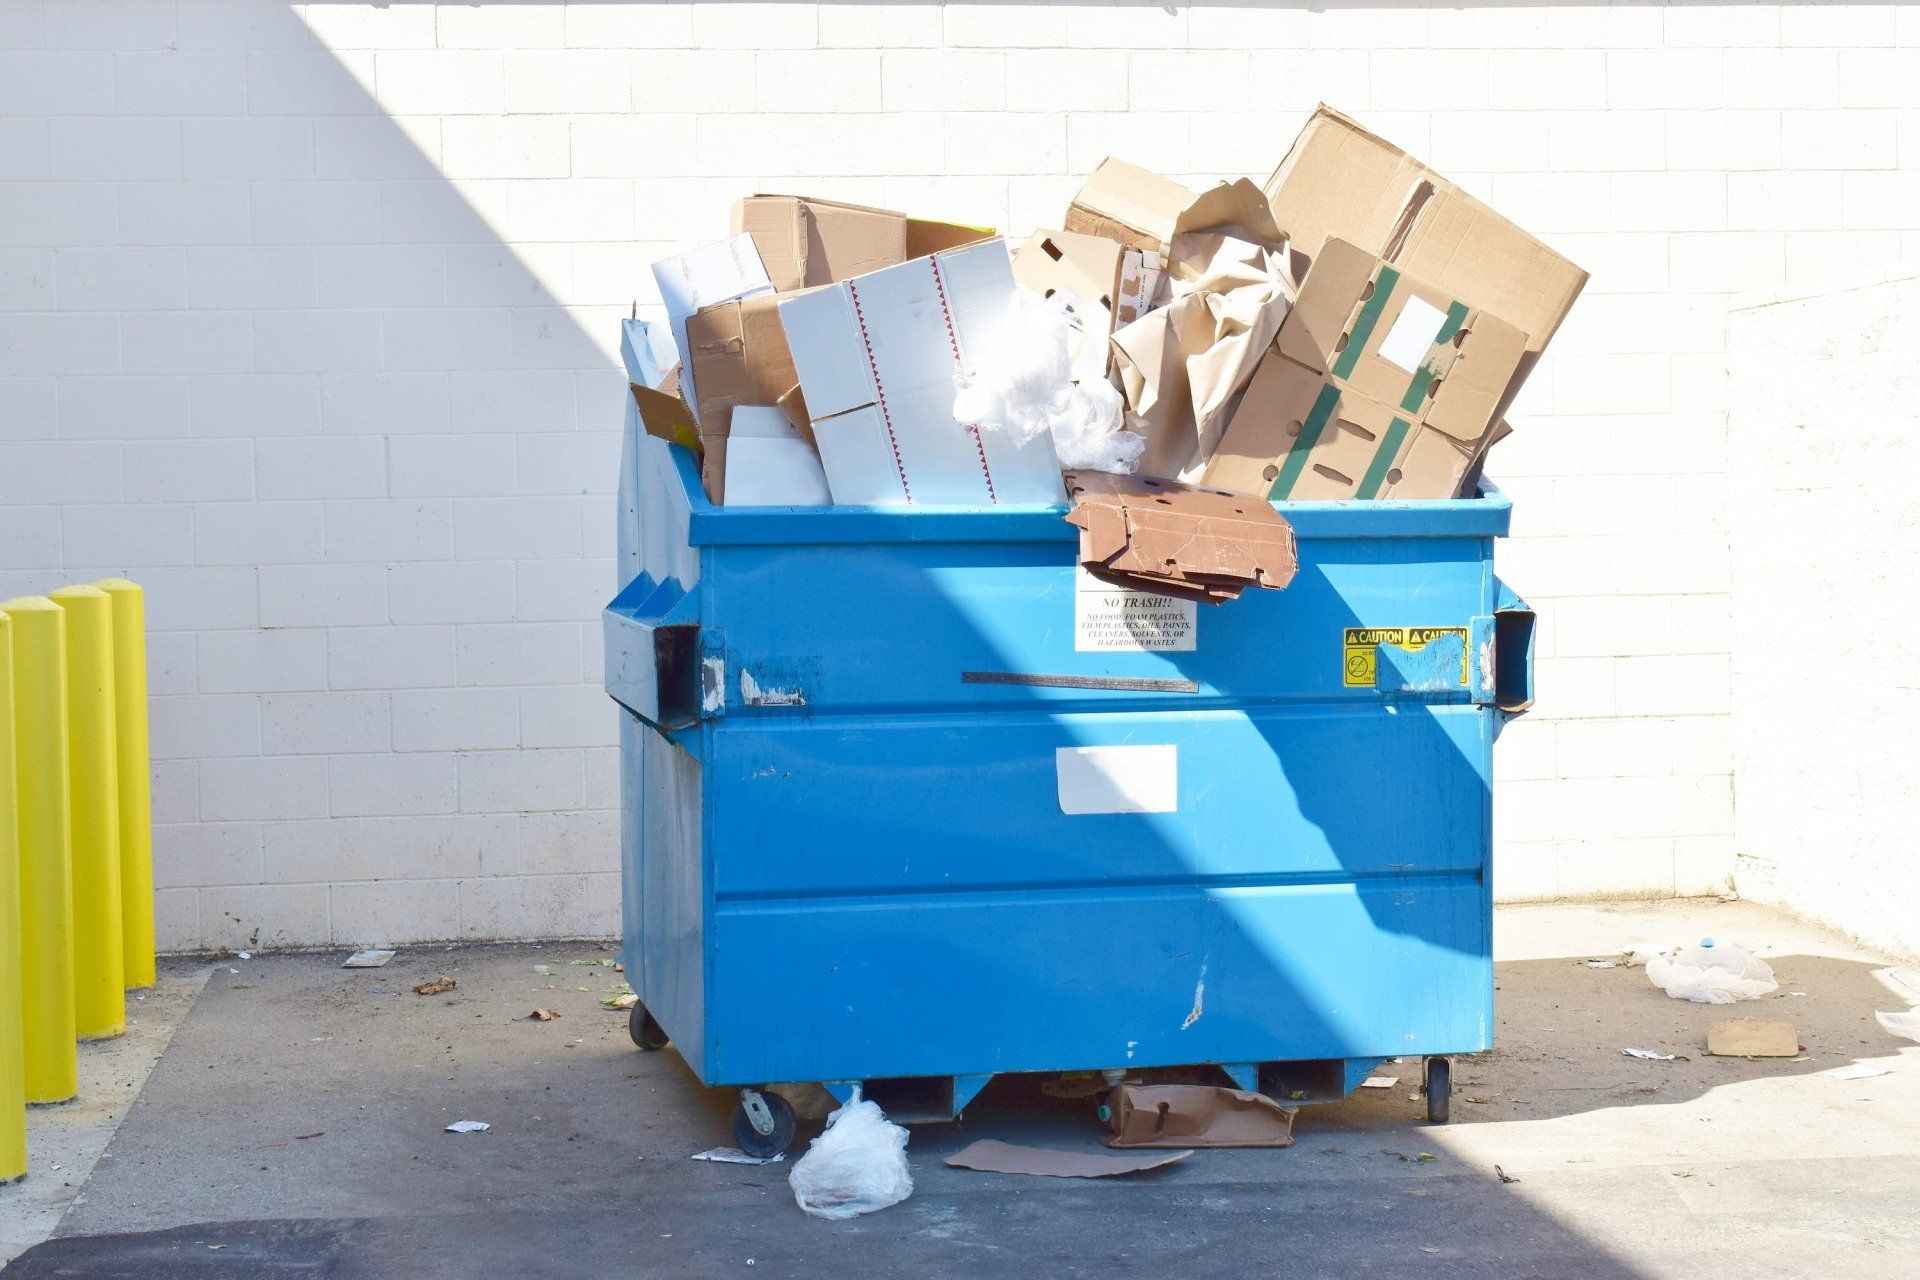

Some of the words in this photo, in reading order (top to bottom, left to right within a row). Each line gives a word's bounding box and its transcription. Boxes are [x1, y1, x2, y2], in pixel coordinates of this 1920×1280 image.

[1102, 597, 1120, 608] NO
[1123, 597, 1172, 608] TRASH!!
[1149, 613, 1186, 621] PLASTICS,
[1359, 630, 1402, 642] CAUTION
